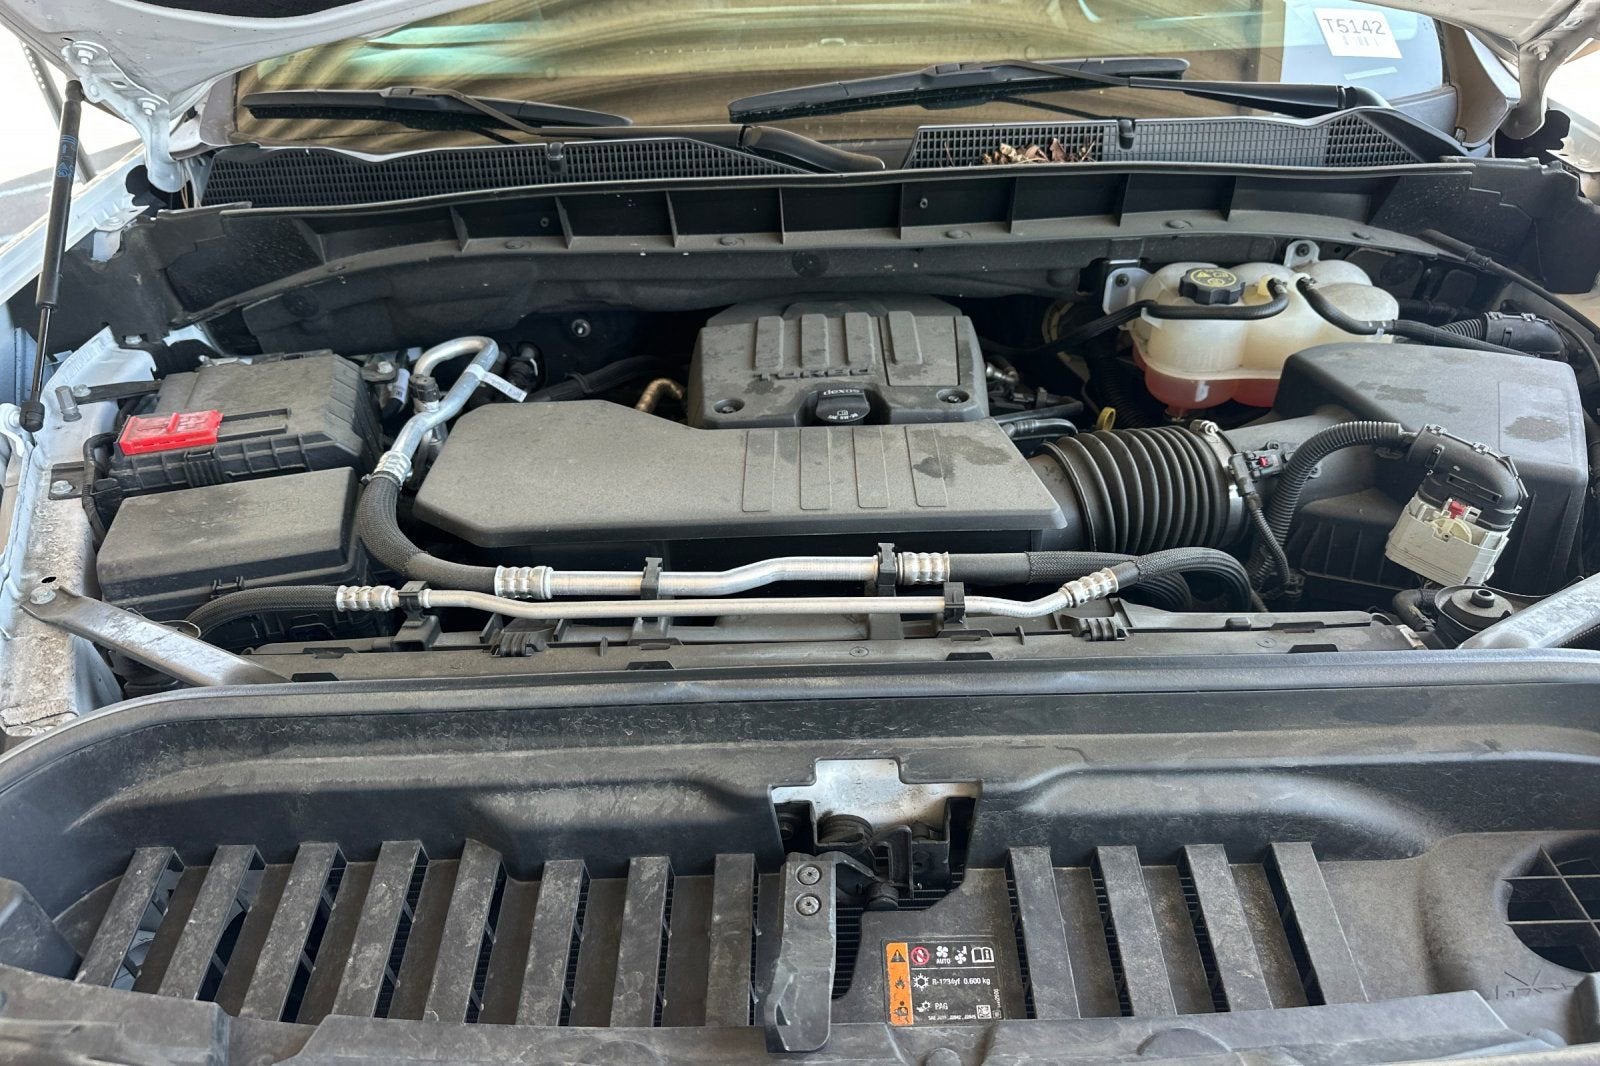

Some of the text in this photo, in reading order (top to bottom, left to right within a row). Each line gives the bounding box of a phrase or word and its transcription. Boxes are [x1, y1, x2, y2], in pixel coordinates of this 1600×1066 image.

[1322, 18, 1386, 35] T5142
[963, 977, 981, 985] 0.600
[982, 977, 991, 986] kg
[934, 1002, 949, 1010] PAG
